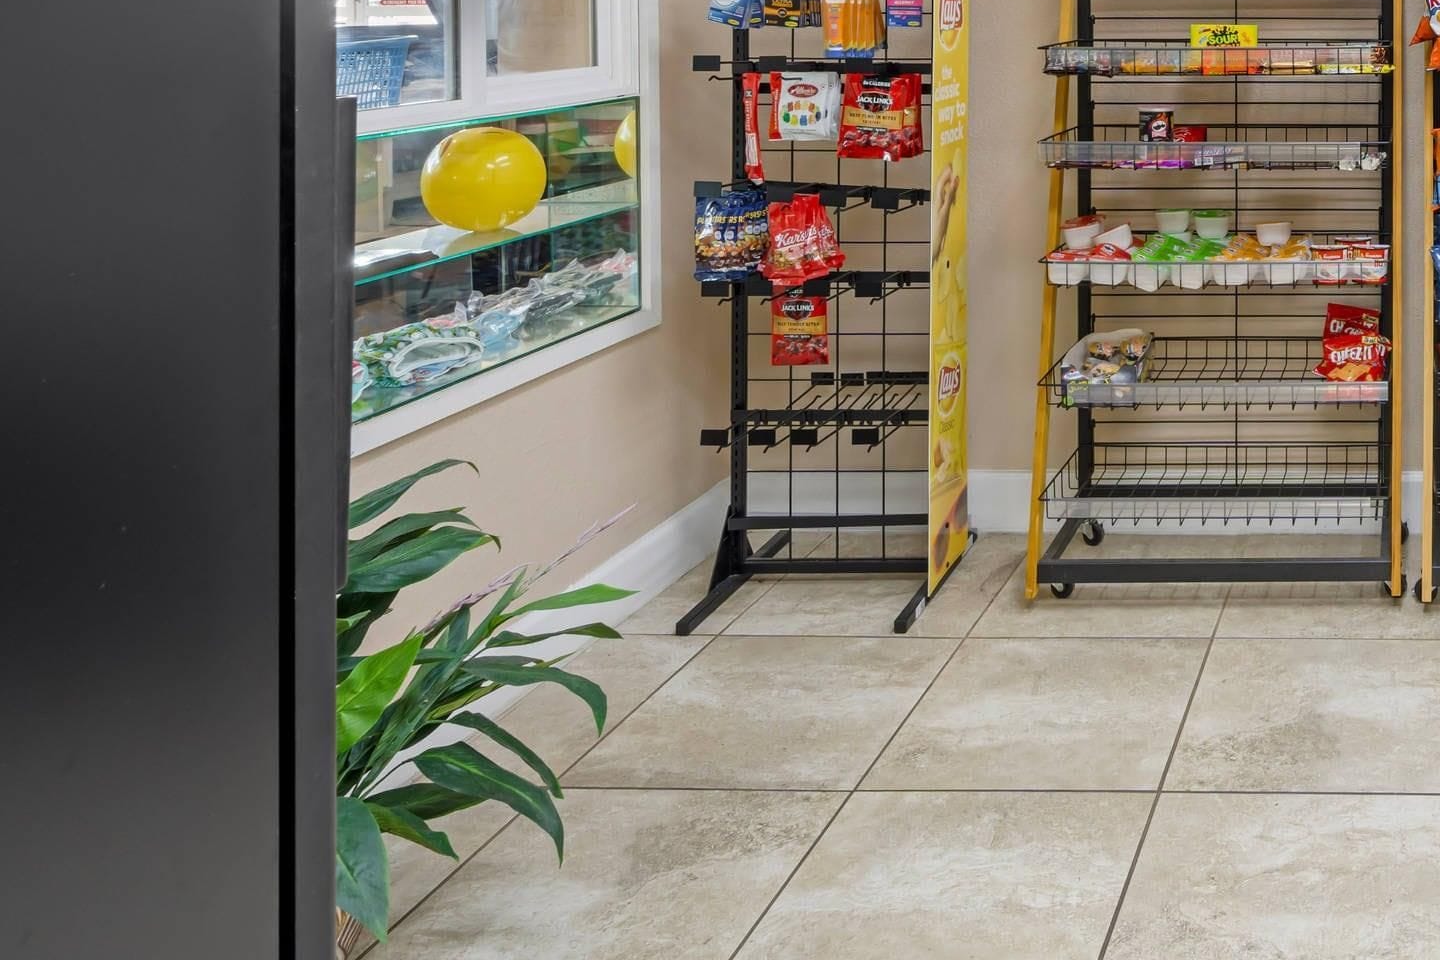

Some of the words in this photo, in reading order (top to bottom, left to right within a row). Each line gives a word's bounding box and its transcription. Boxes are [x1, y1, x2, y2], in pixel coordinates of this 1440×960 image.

[1207, 34, 1238, 45] SOUR
[856, 95, 873, 104] JACK
[955, 102, 967, 117] to
[940, 120, 964, 146] snack
[938, 365, 960, 400] Lay's
